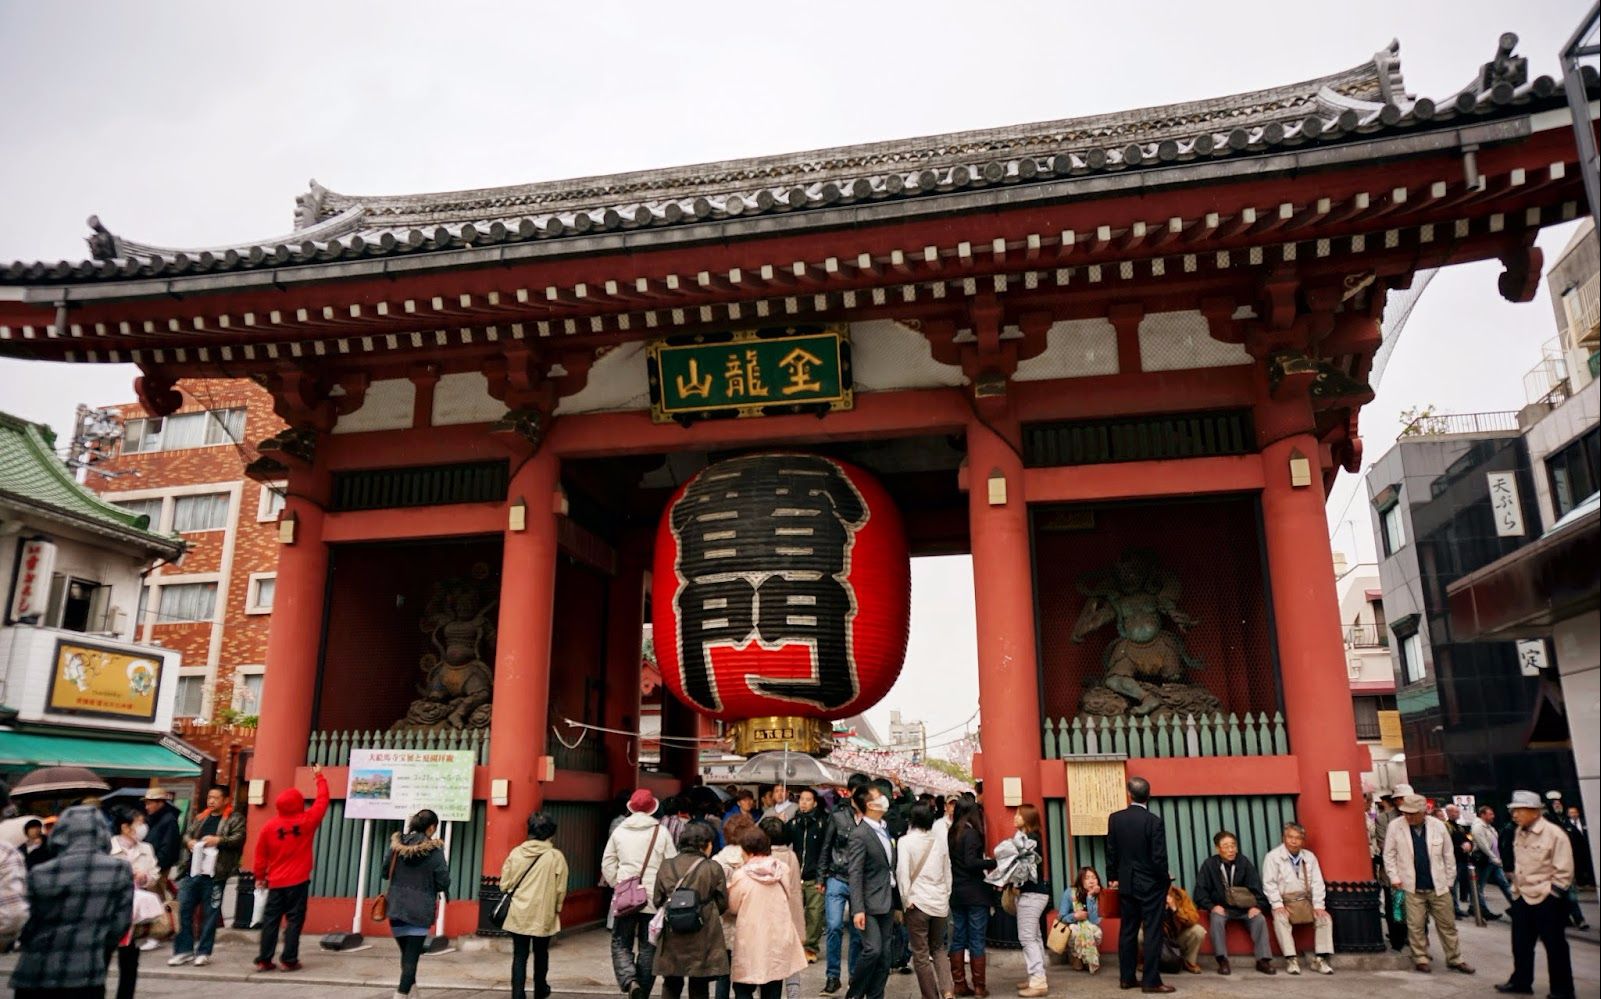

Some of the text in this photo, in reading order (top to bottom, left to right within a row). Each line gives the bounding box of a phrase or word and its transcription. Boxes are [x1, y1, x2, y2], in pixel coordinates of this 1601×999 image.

[1493, 478, 1516, 530] 天ぷら
[669, 454, 871, 713] 雷門
[1519, 640, 1541, 668] 定
